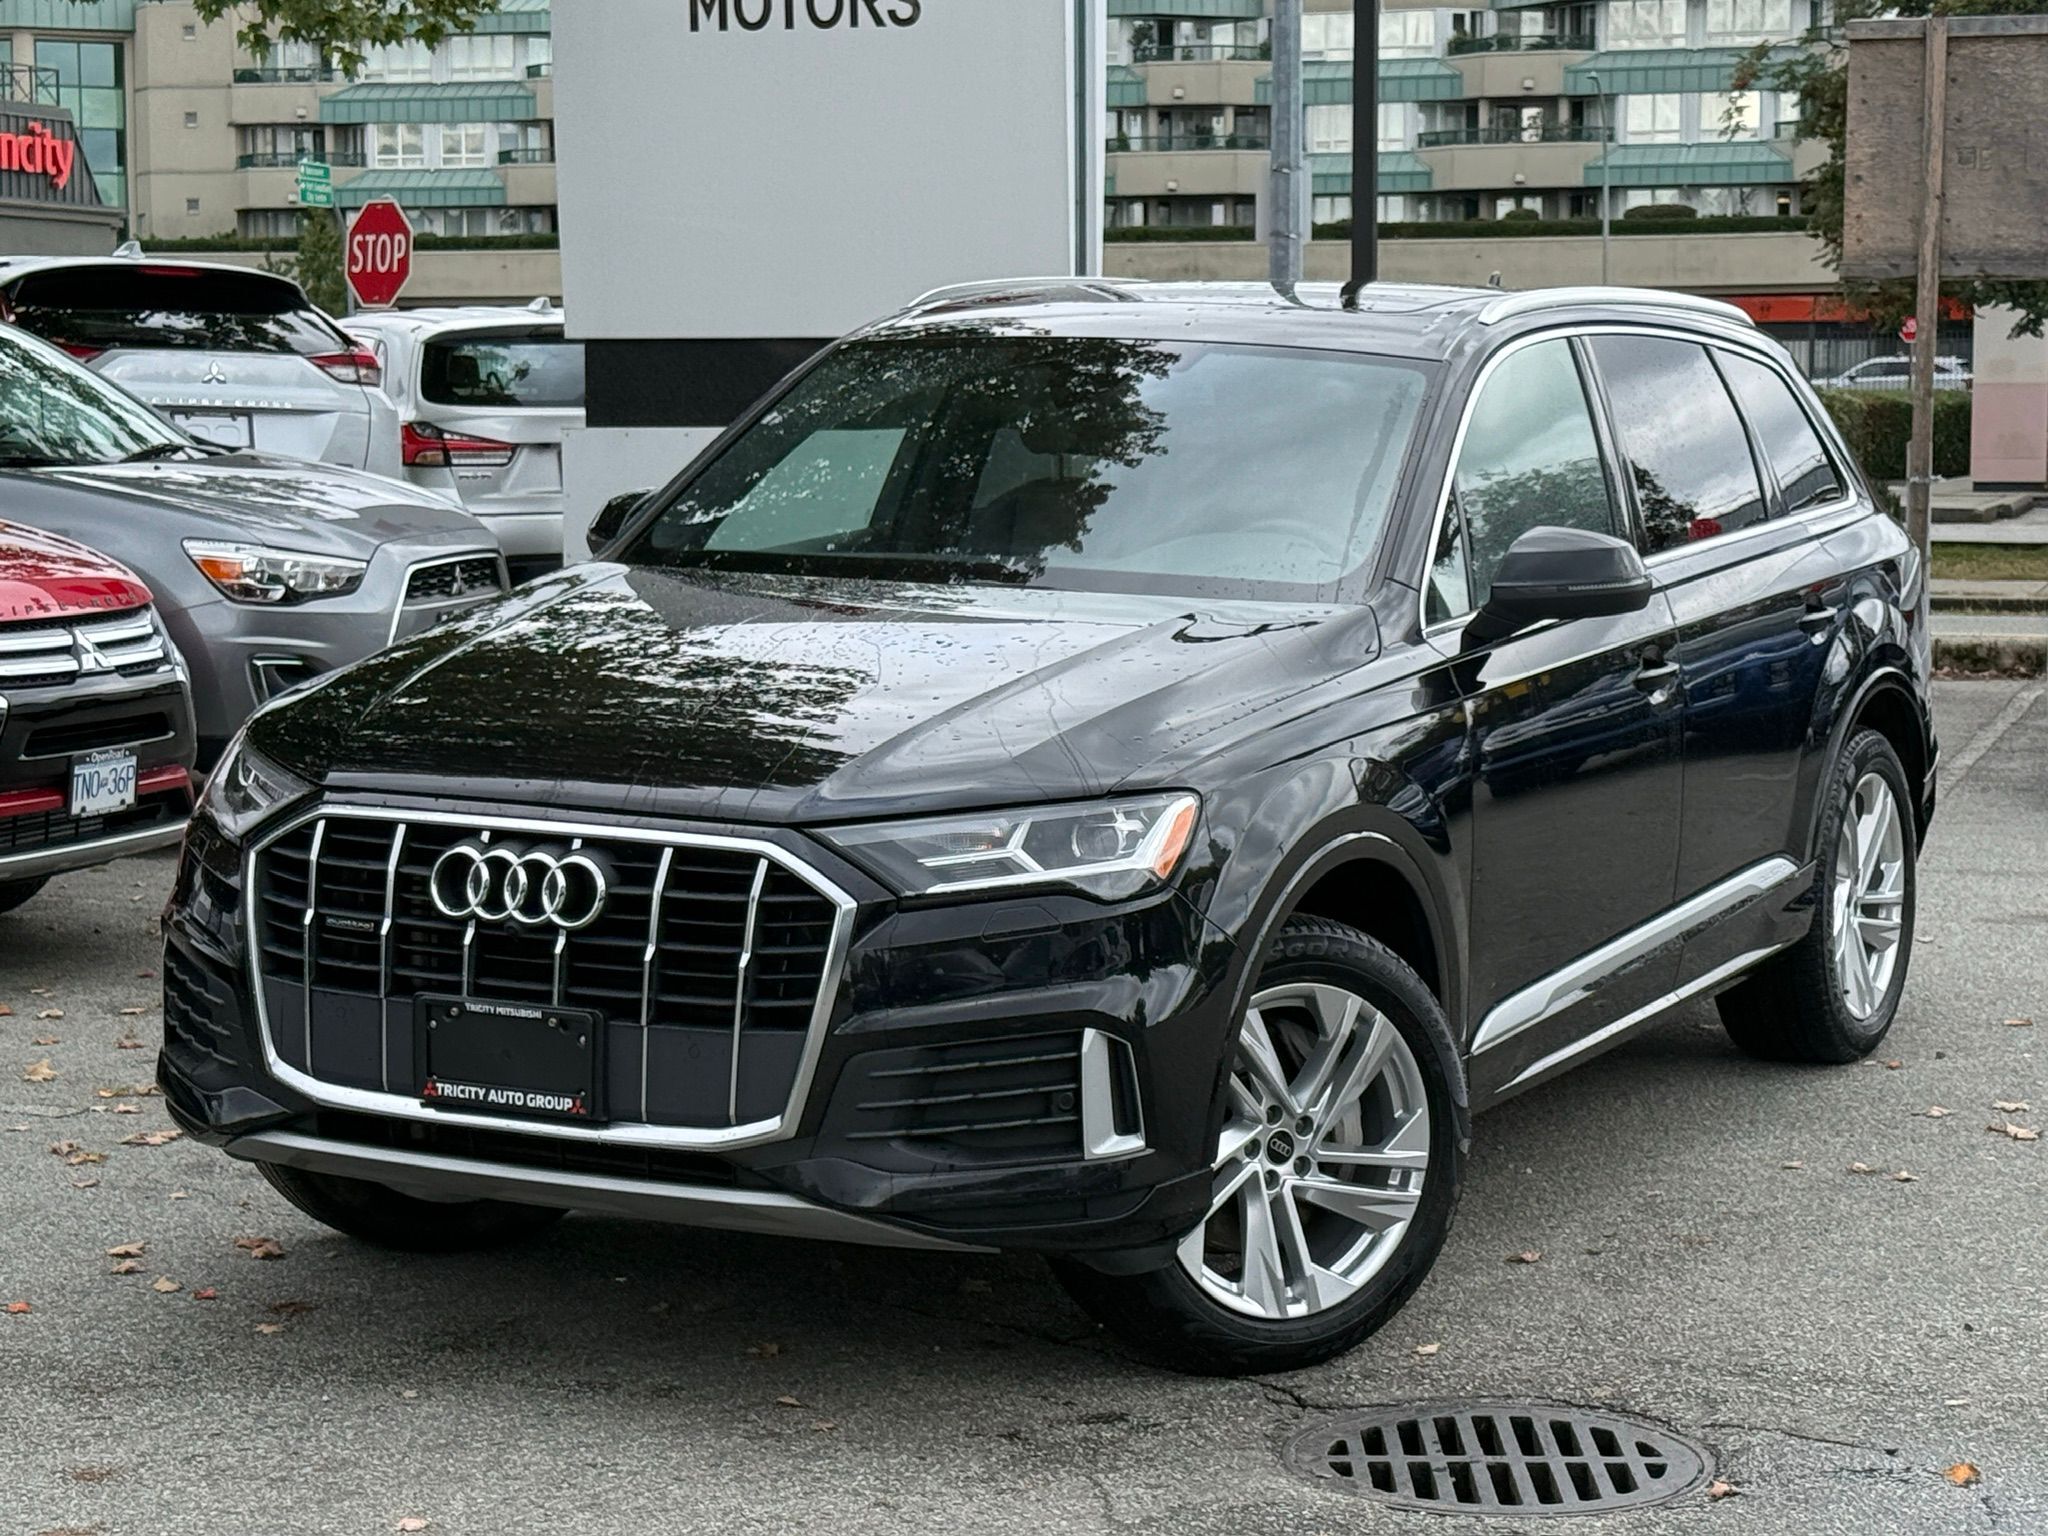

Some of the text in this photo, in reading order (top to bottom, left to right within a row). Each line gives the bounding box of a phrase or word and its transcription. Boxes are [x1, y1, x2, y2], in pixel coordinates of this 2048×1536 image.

[351, 233, 407, 274] STOP
[465, 1002, 494, 1013] TRICITY
[436, 1083, 573, 1111] TRICITY AUTO GROUP
